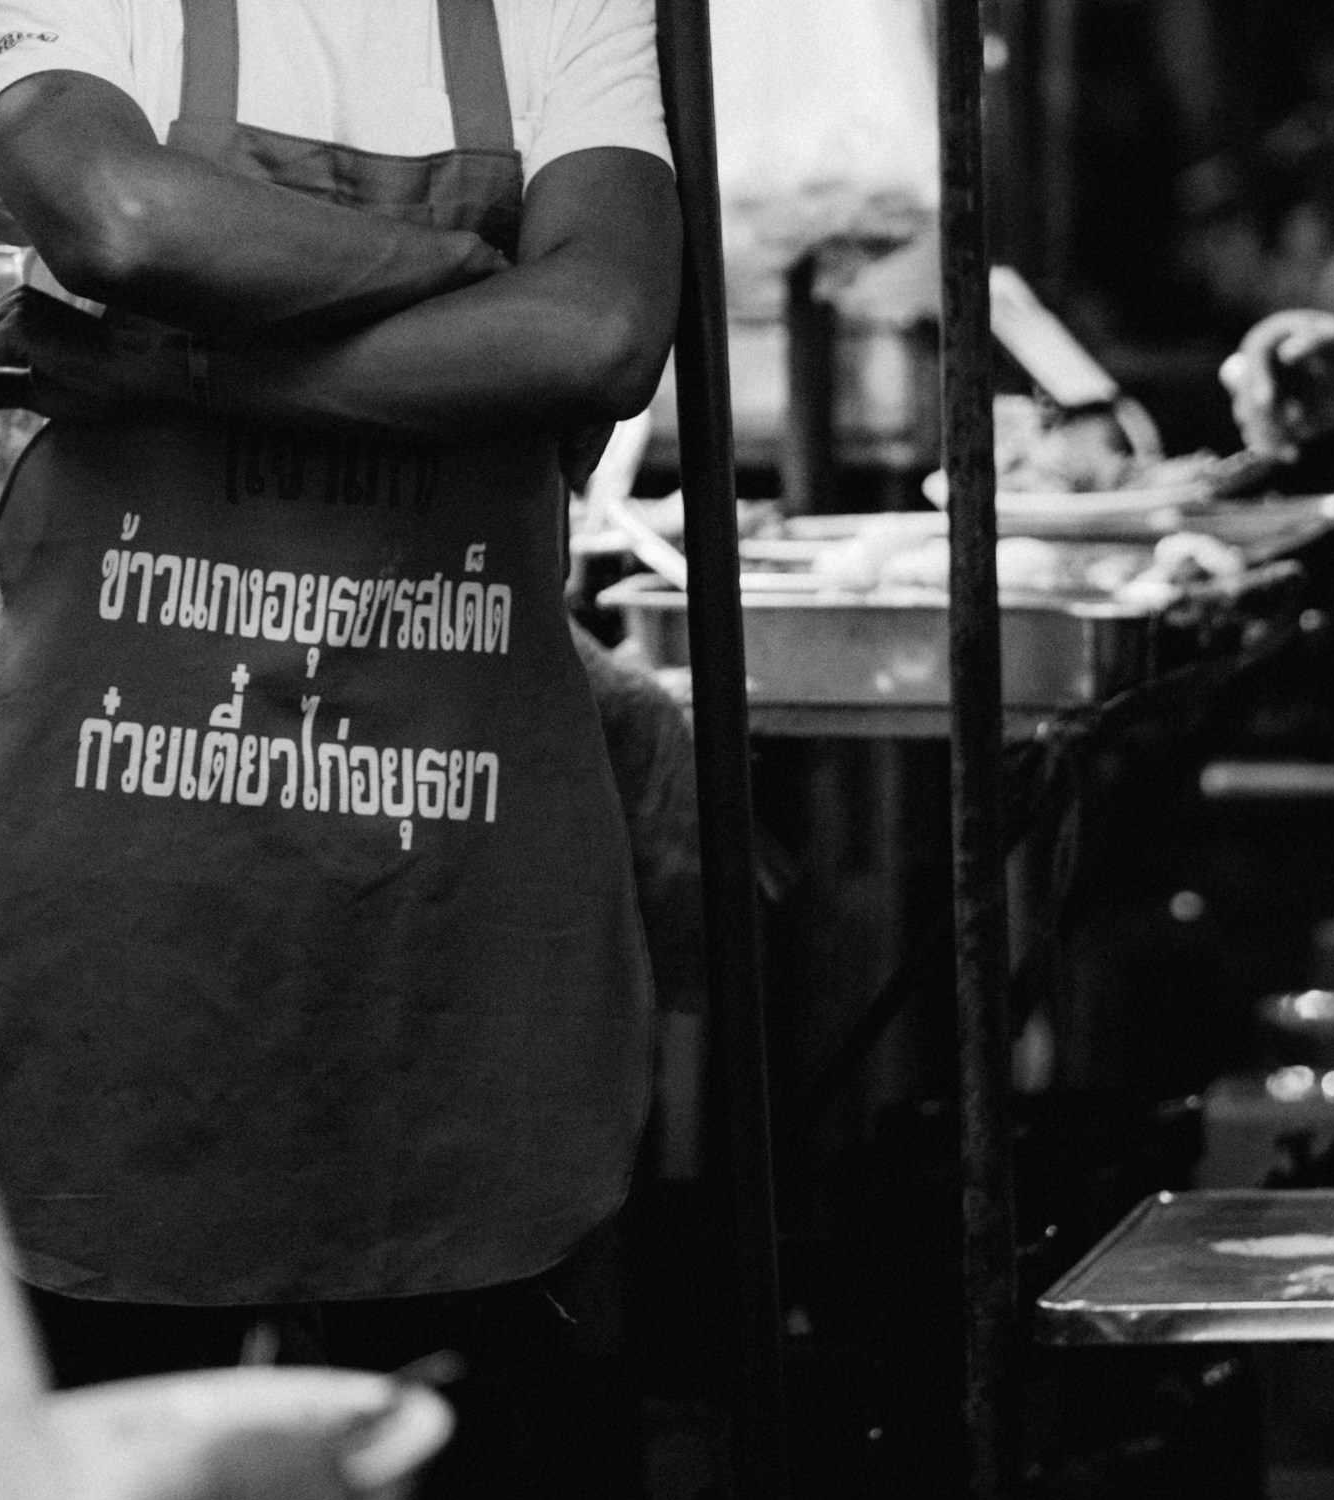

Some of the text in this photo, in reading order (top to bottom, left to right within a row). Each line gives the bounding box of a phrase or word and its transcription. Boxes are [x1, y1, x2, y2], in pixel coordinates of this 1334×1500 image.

[75, 664, 499, 851] ก๋วยเตี๋ยวไก่อยุธยา
